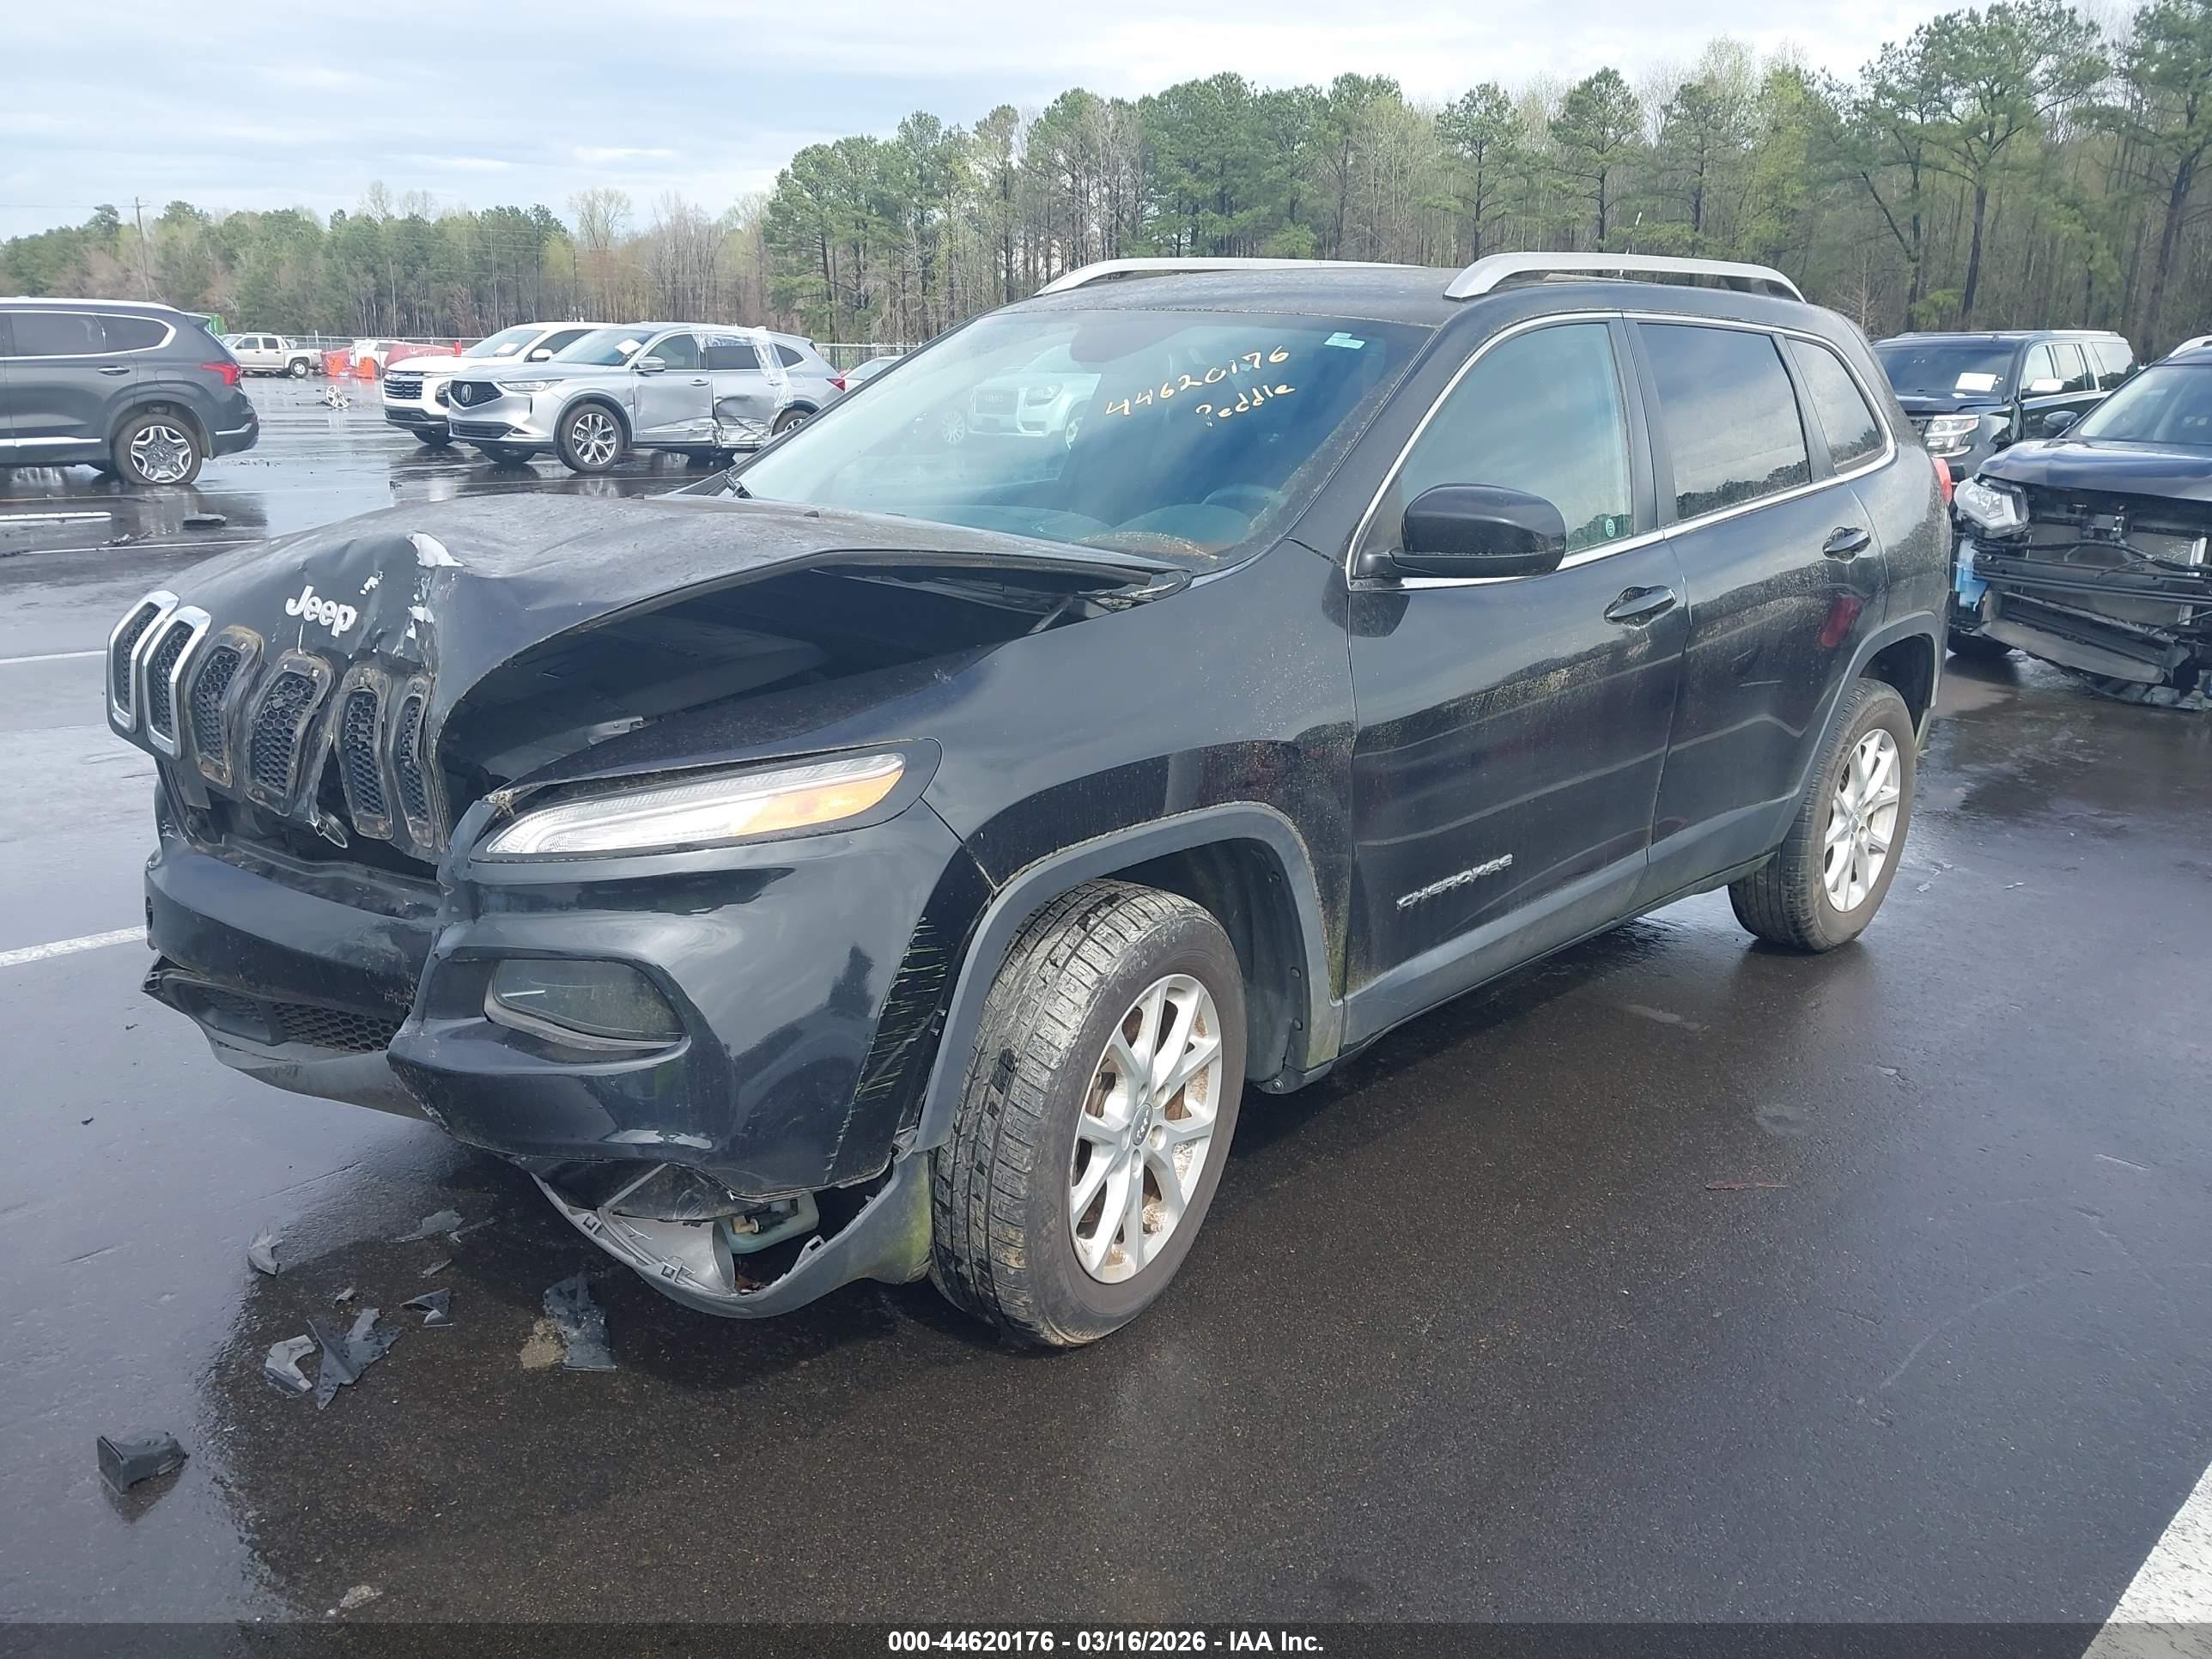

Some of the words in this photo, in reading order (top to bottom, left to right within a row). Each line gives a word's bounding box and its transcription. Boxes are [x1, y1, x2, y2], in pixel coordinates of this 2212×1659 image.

[1105, 344, 1291, 416] 44620176
[285, 585, 358, 638] Jeep
[1396, 853, 1514, 910] CHEROKEE
